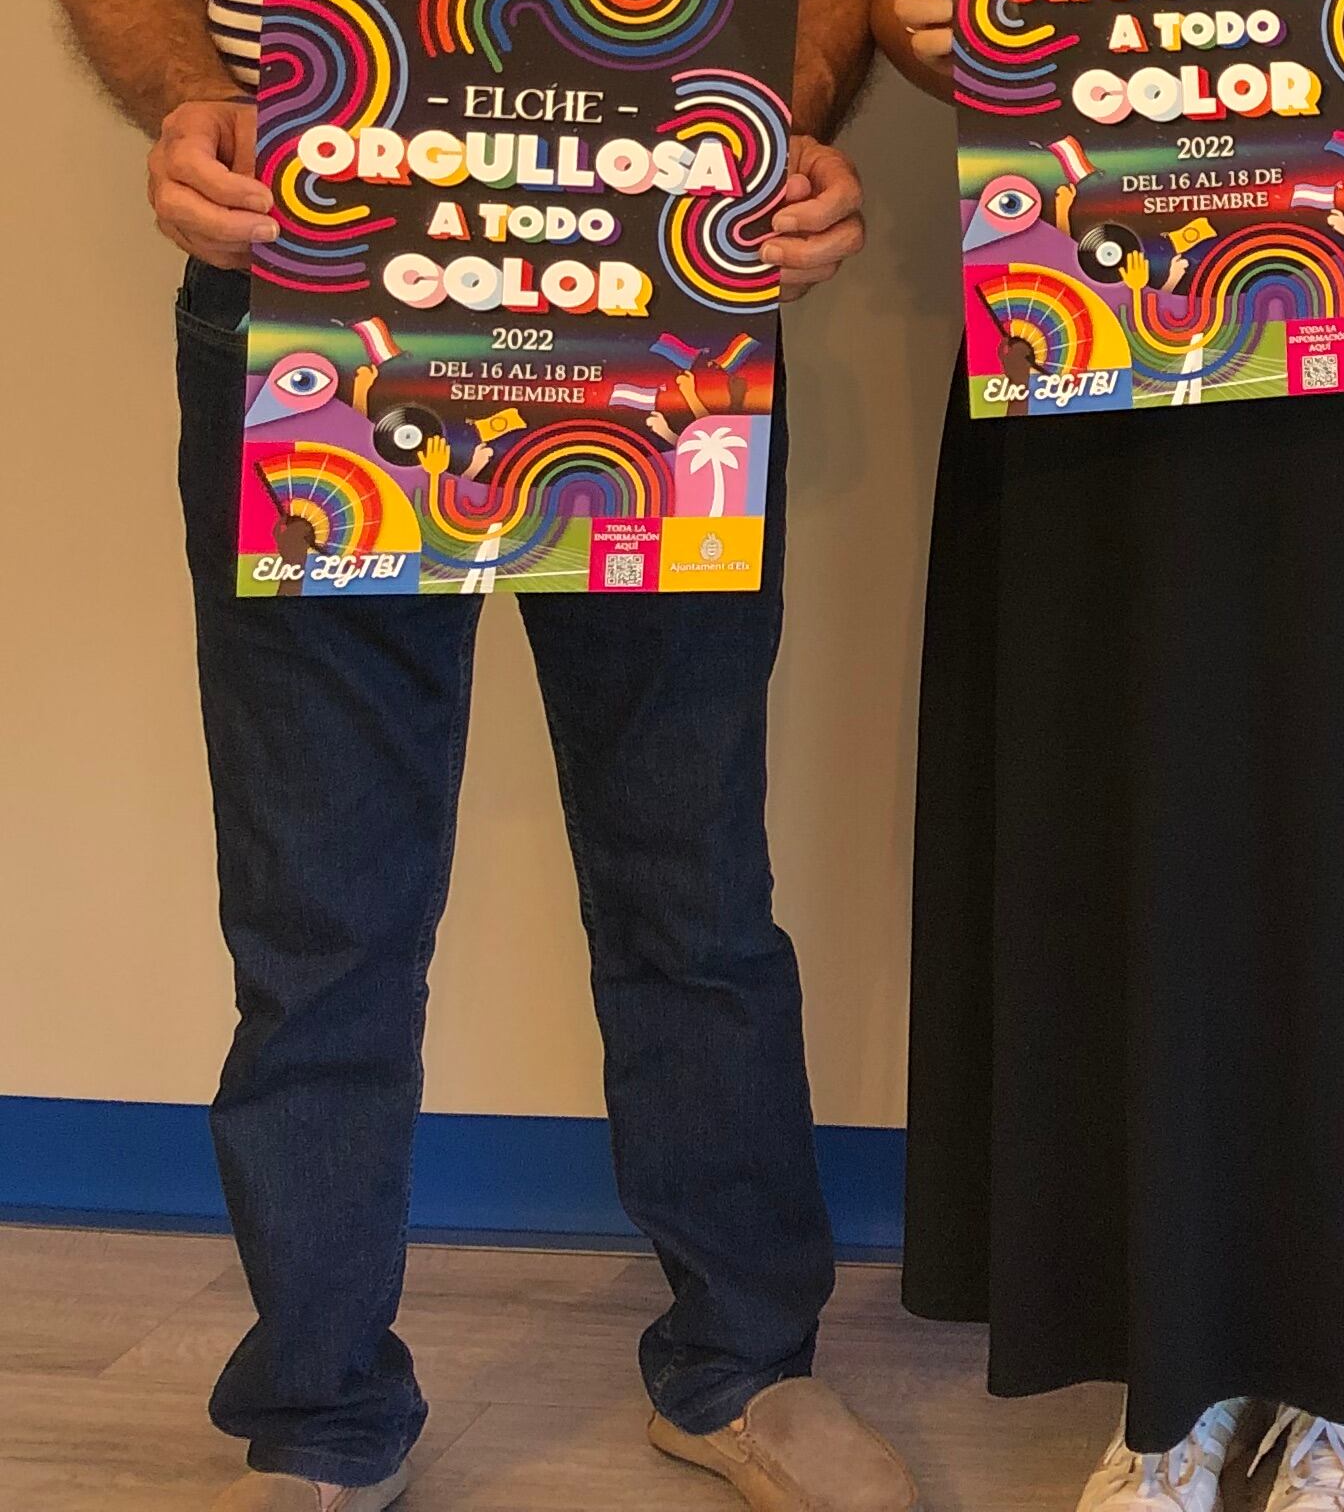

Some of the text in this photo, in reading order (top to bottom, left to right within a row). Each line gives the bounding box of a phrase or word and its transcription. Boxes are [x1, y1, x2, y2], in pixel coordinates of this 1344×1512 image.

[1108, 8, 1286, 53] A TODO
[463, 82, 603, 123] ELCHE
[1071, 60, 1321, 125] COLOR
[297, 123, 744, 198] ORGULLOSA
[1176, 135, 1234, 159] 2022
[1122, 167, 1282, 191] DEL 16 AL 18 DE
[1143, 190, 1268, 213] SEPTIEMBRE
[427, 200, 622, 245] A TODO
[381, 252, 654, 315] COLOR
[490, 327, 554, 351] 2022
[428, 361, 602, 379] DEL 16 AL 18 DE
[449, 384, 585, 402] SEPTIEMBRE
[981, 369, 1120, 408] Elx LGTBI
[253, 554, 406, 587] Elx LGTBI
[670, 563, 725, 573] Ajuntament
